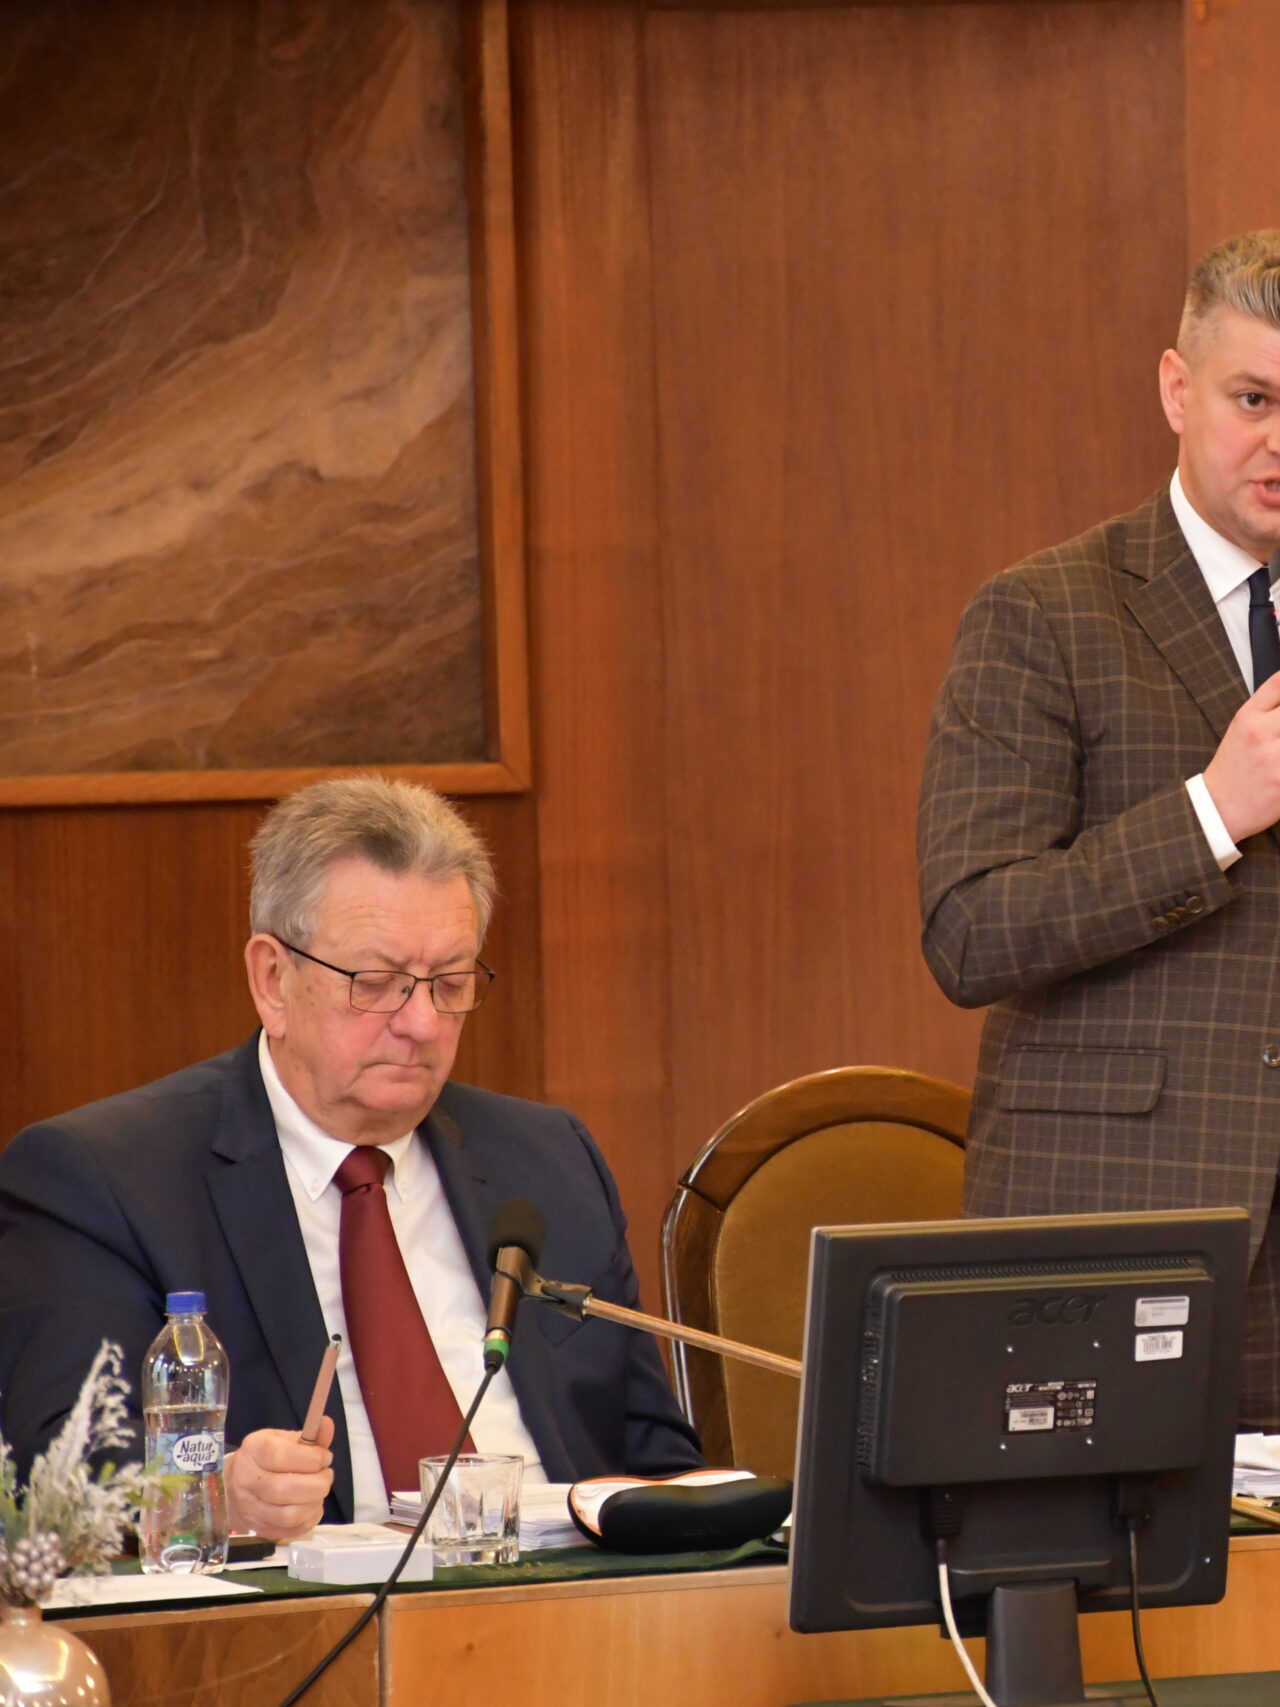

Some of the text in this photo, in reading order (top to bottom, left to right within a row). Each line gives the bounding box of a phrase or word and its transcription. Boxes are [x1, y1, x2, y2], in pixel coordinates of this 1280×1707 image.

[1008, 1294, 1110, 1326] acer
[1006, 1384, 1033, 1393] acer
[180, 1441, 213, 1453] Natur
[182, 1450, 211, 1467] aqua
